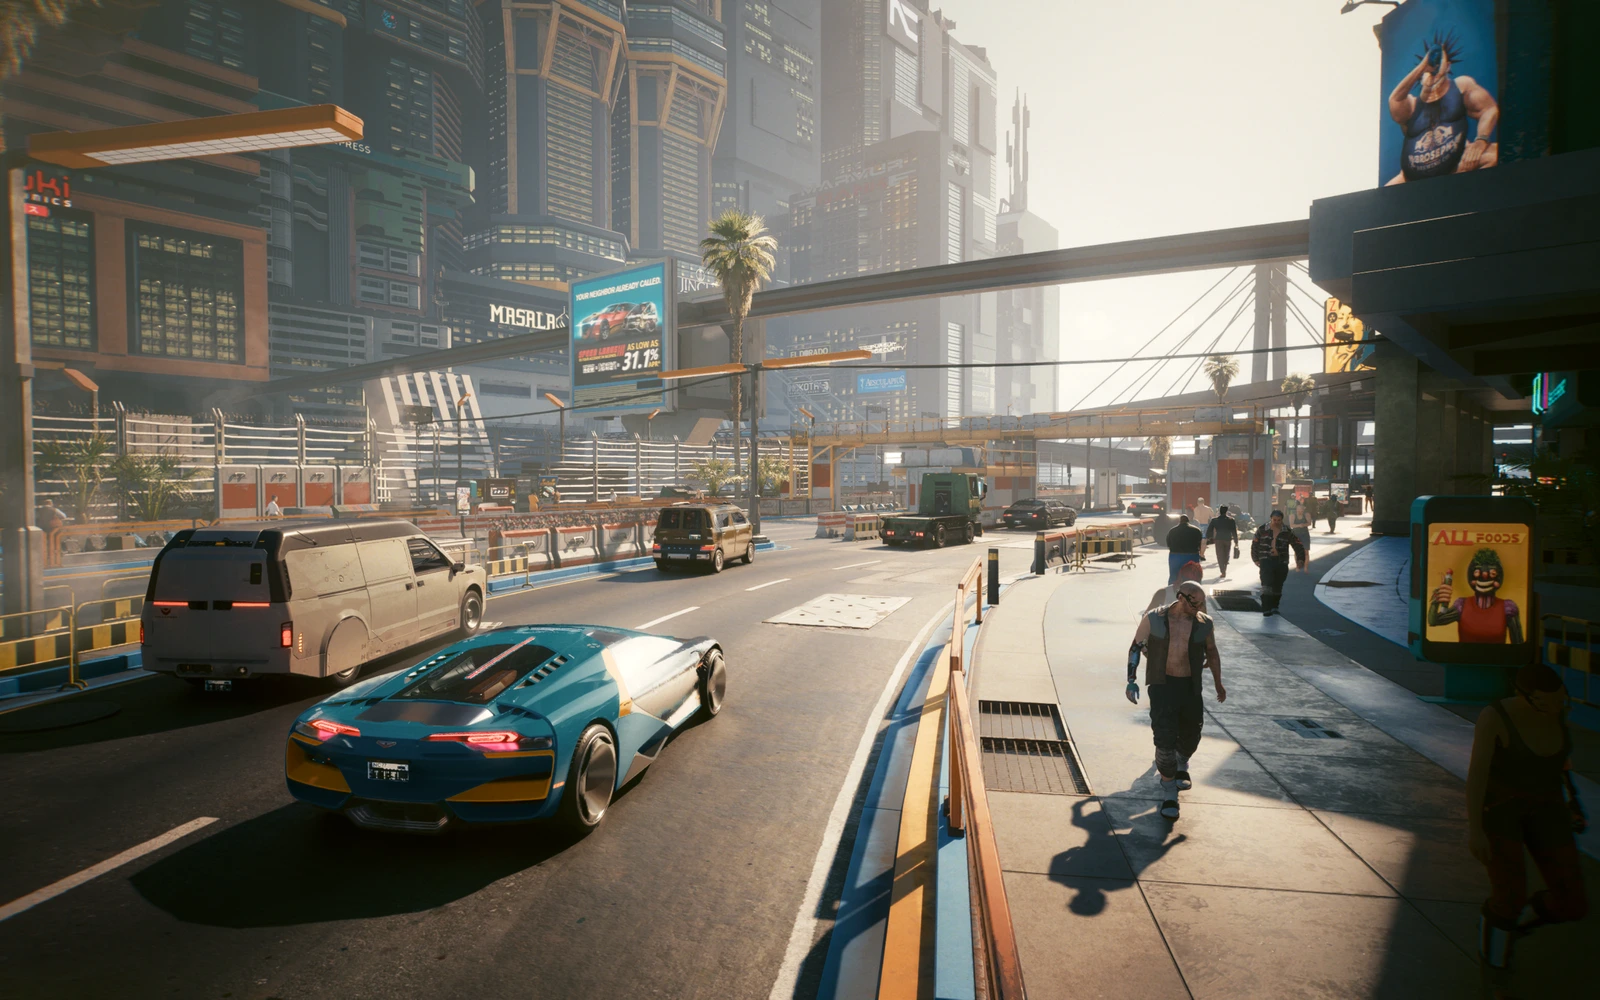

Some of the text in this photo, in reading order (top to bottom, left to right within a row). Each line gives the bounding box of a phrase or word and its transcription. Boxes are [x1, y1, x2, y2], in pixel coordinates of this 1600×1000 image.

[576, 292, 589, 301] YOUR
[589, 287, 615, 299] NEIGHBOR
[615, 281, 639, 293] ALREADY
[489, 304, 556, 330] MASALA
[627, 339, 659, 351] AS LOW AS
[1432, 528, 1520, 546] ALL FOODS
